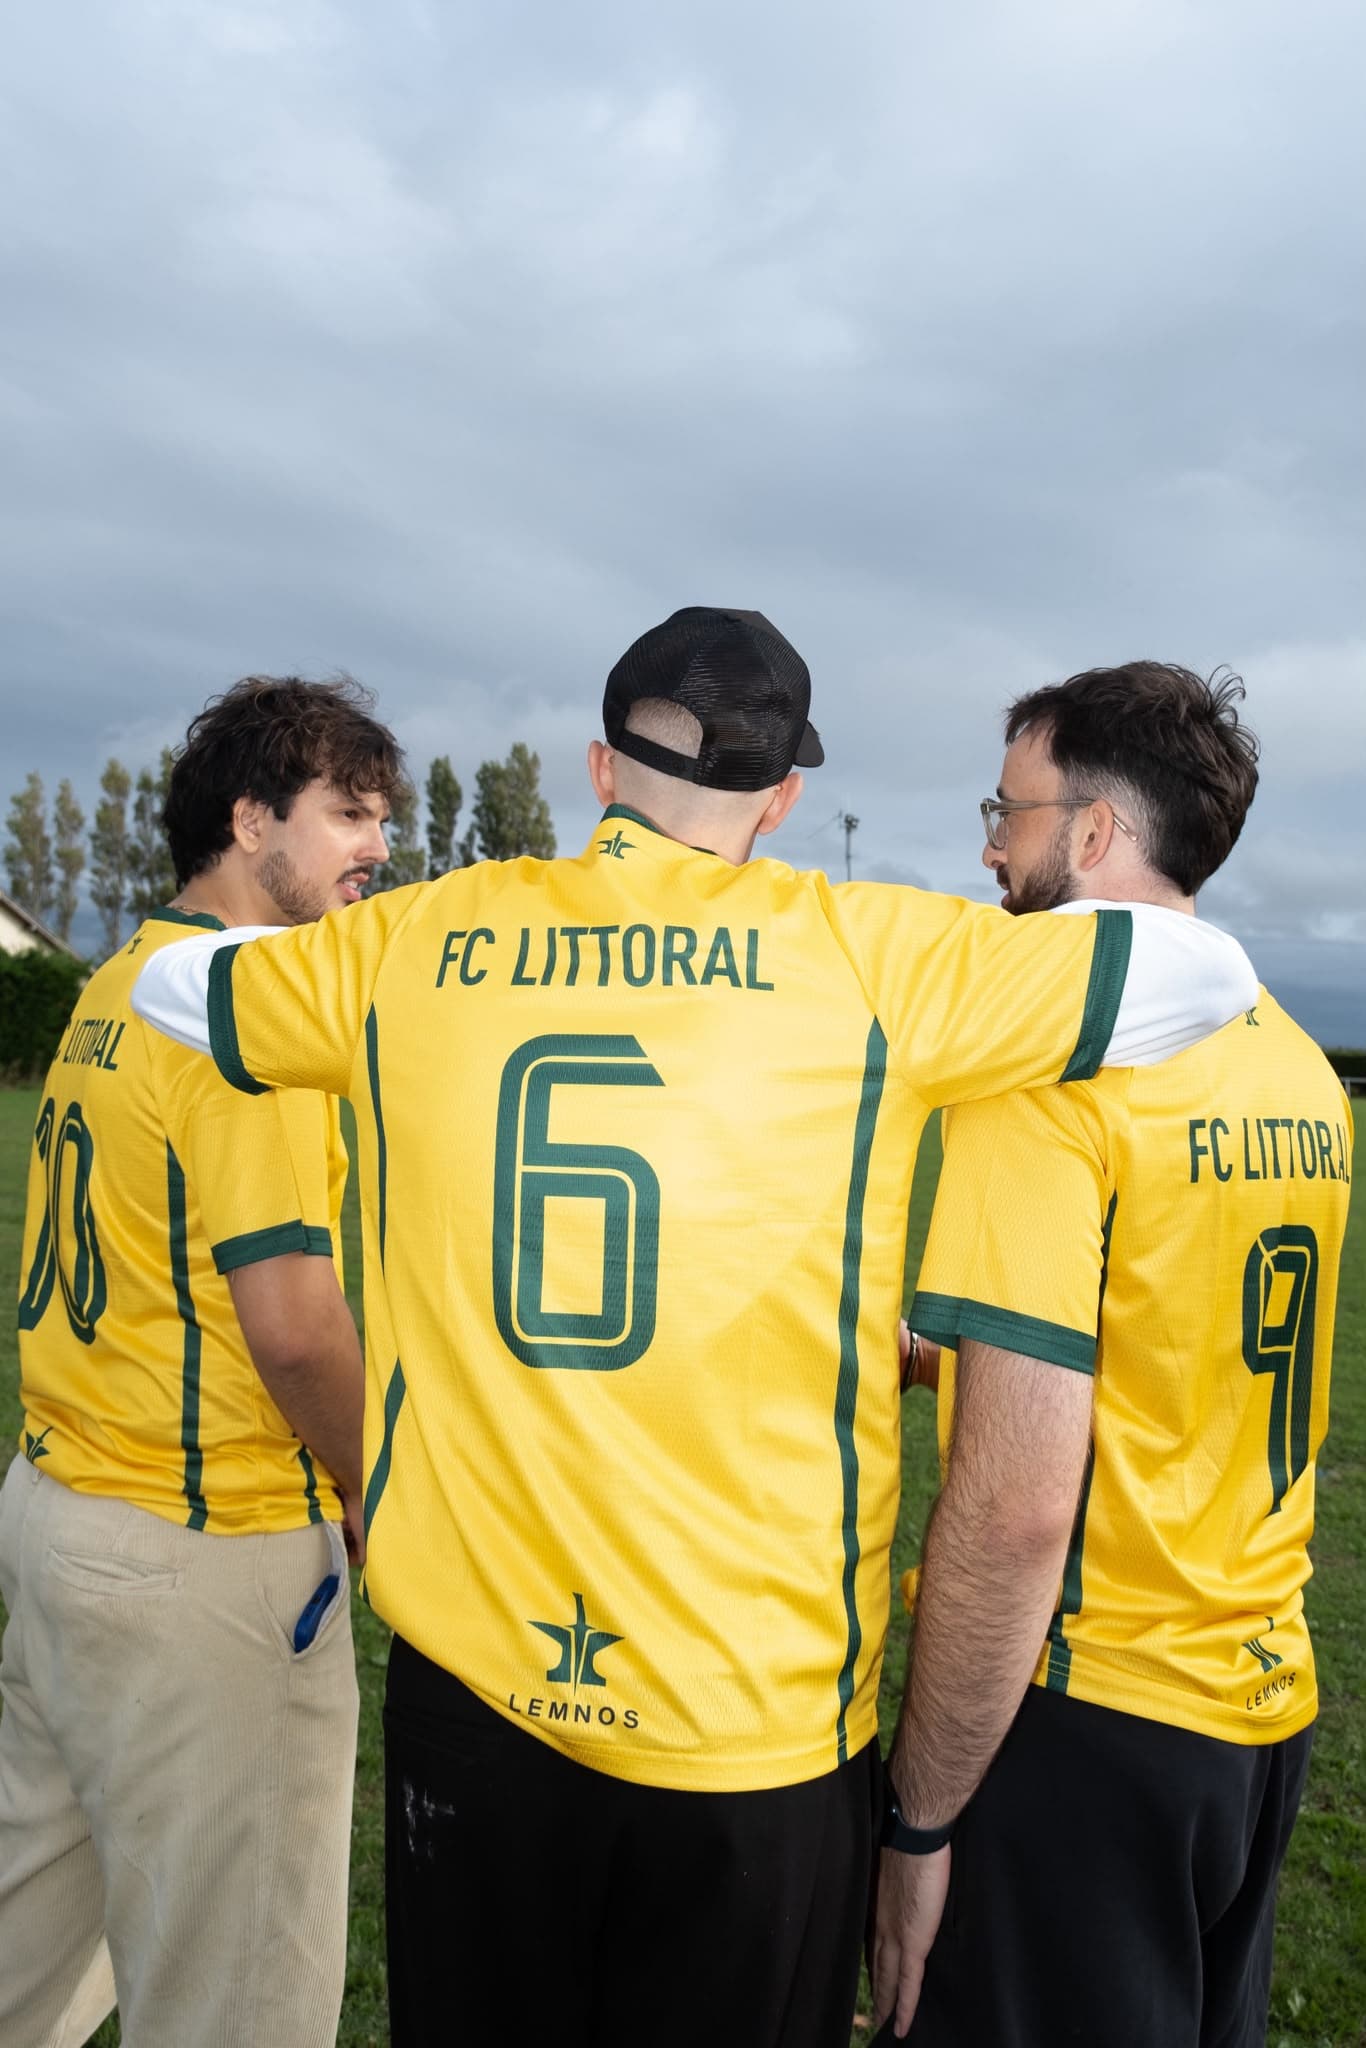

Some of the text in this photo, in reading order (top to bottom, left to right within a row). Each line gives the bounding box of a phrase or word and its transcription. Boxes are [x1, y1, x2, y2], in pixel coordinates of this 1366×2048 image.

[436, 923, 774, 992] FC LITTORAL
[1189, 1118, 1350, 1184] FC LITTORAL
[492, 1033, 666, 1371] 6
[1242, 1224, 1319, 1519] 9
[508, 1693, 639, 1729] LEMNOS
[1246, 1672, 1297, 1711] LEMNOS
